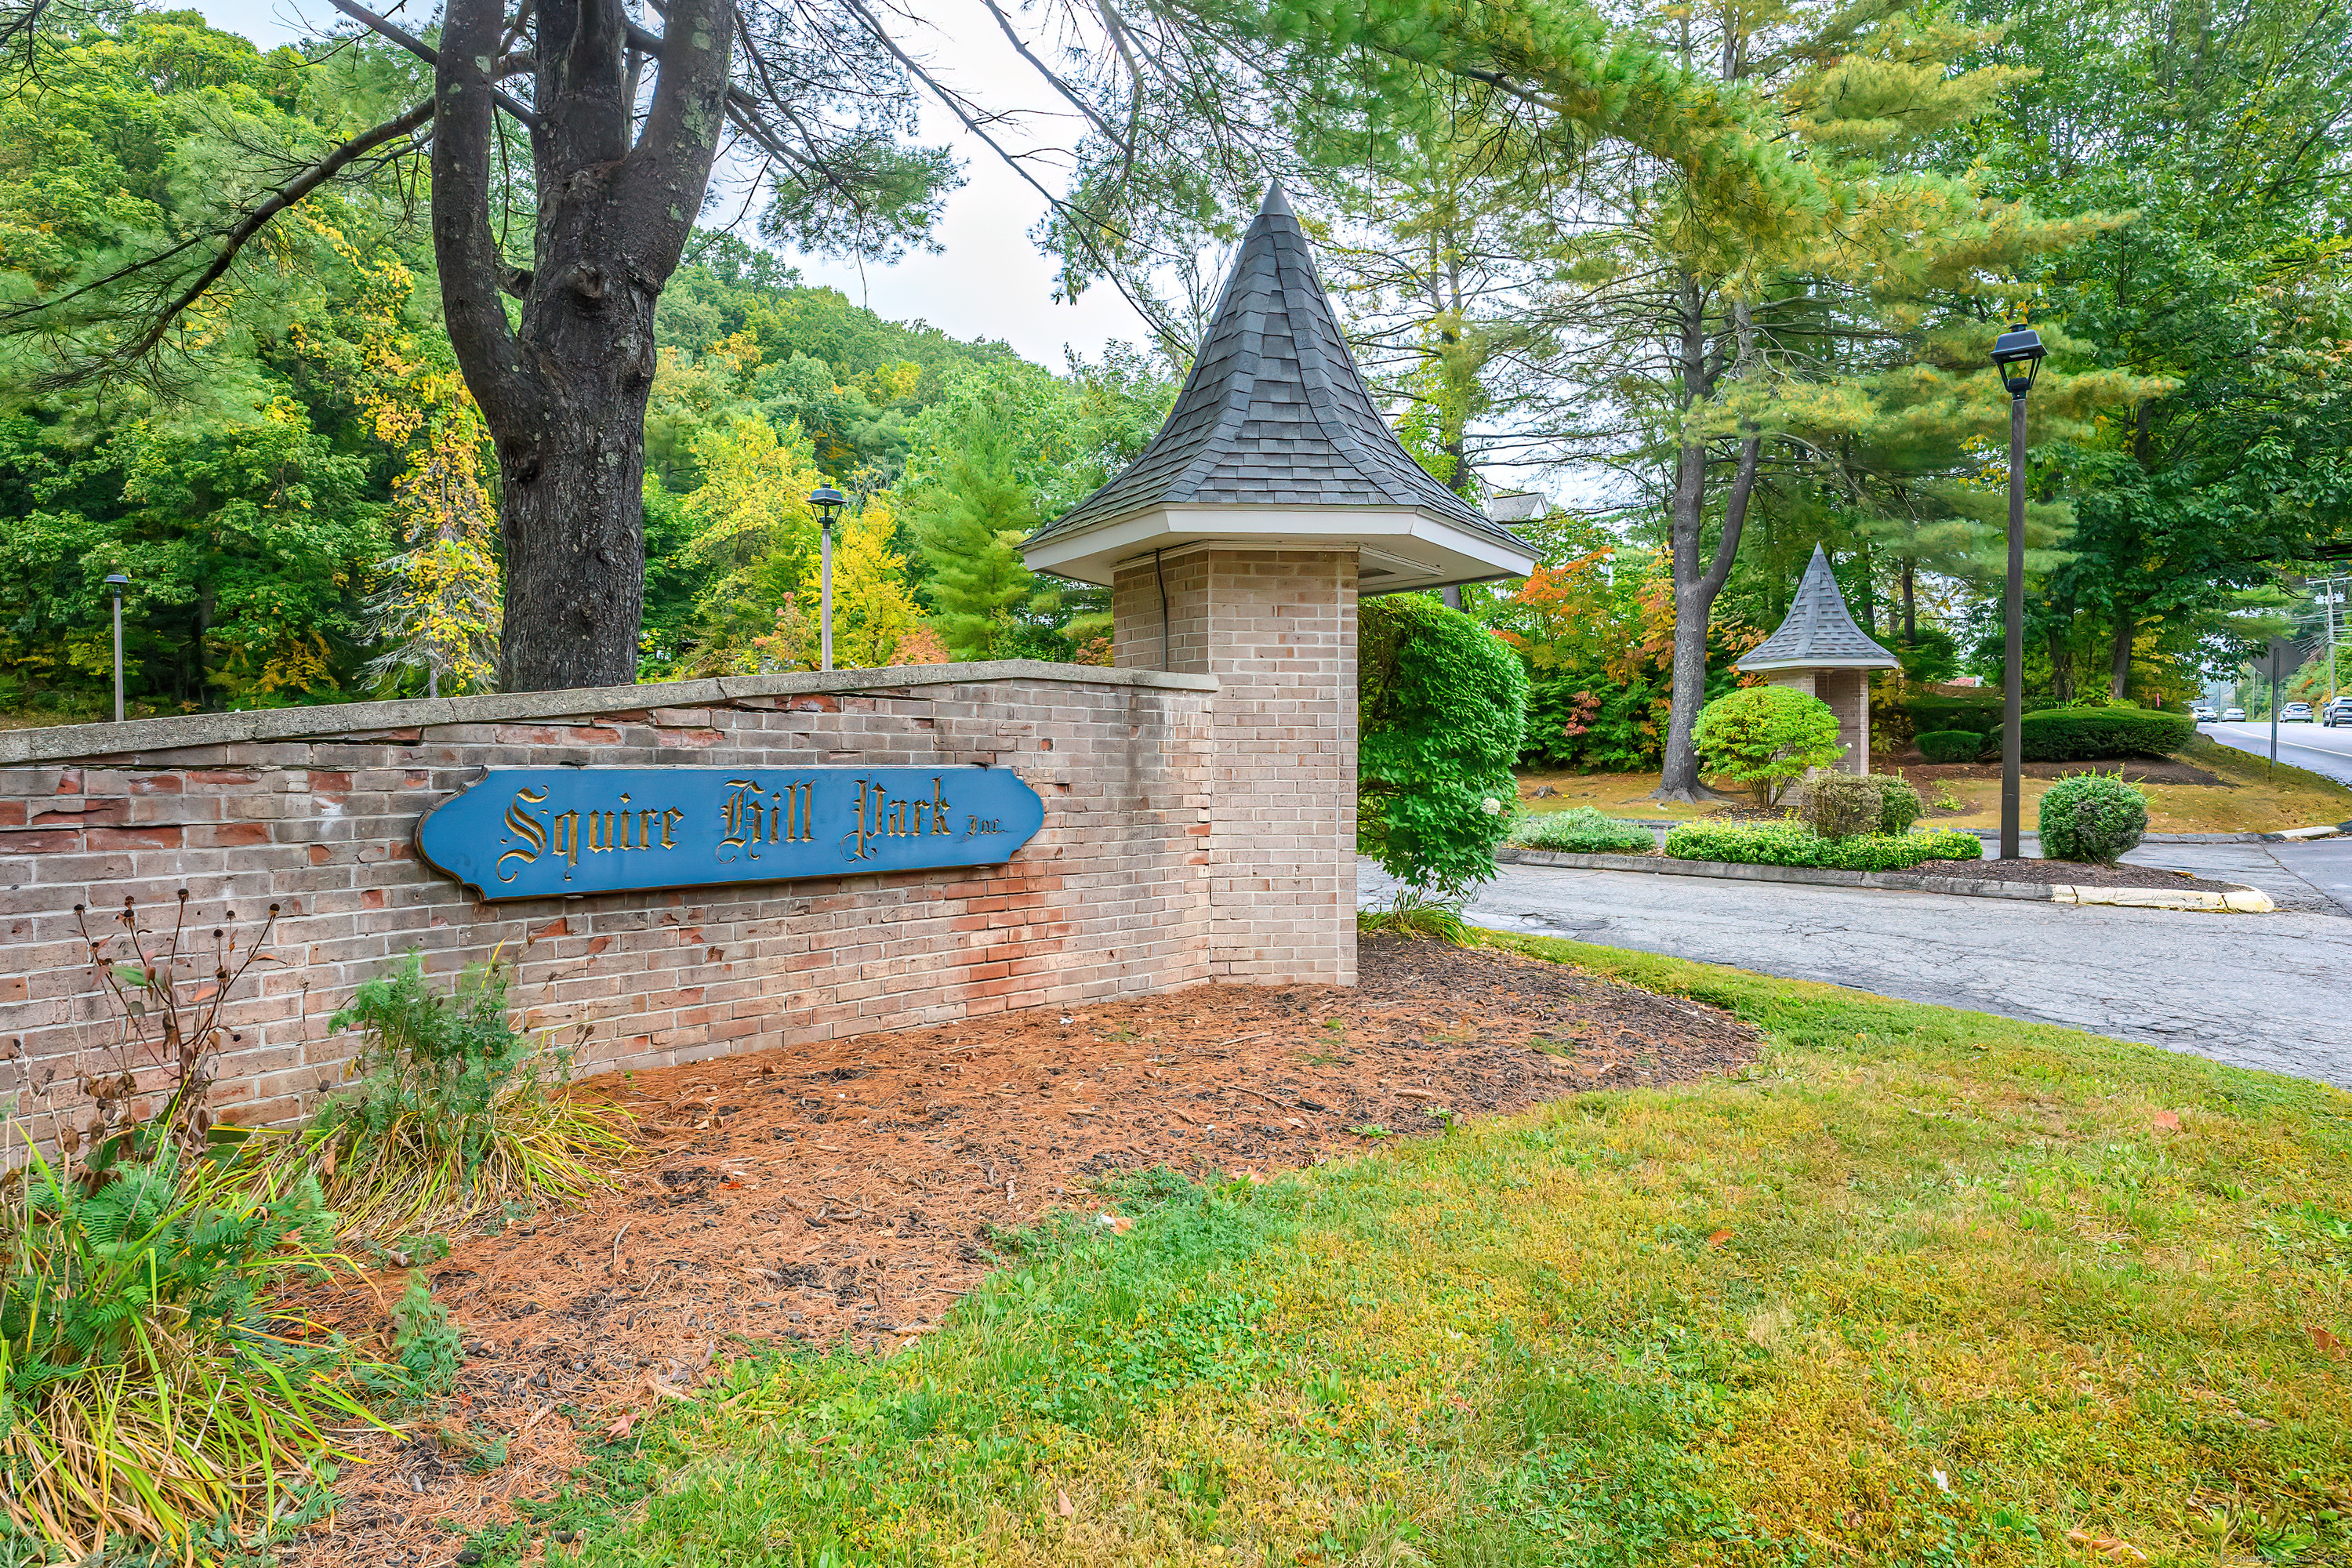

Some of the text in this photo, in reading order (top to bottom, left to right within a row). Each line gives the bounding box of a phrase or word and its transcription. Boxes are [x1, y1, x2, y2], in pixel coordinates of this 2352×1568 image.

[496, 785, 684, 883] Squire
[716, 779, 816, 864] Hill
[839, 774, 951, 862] Park
